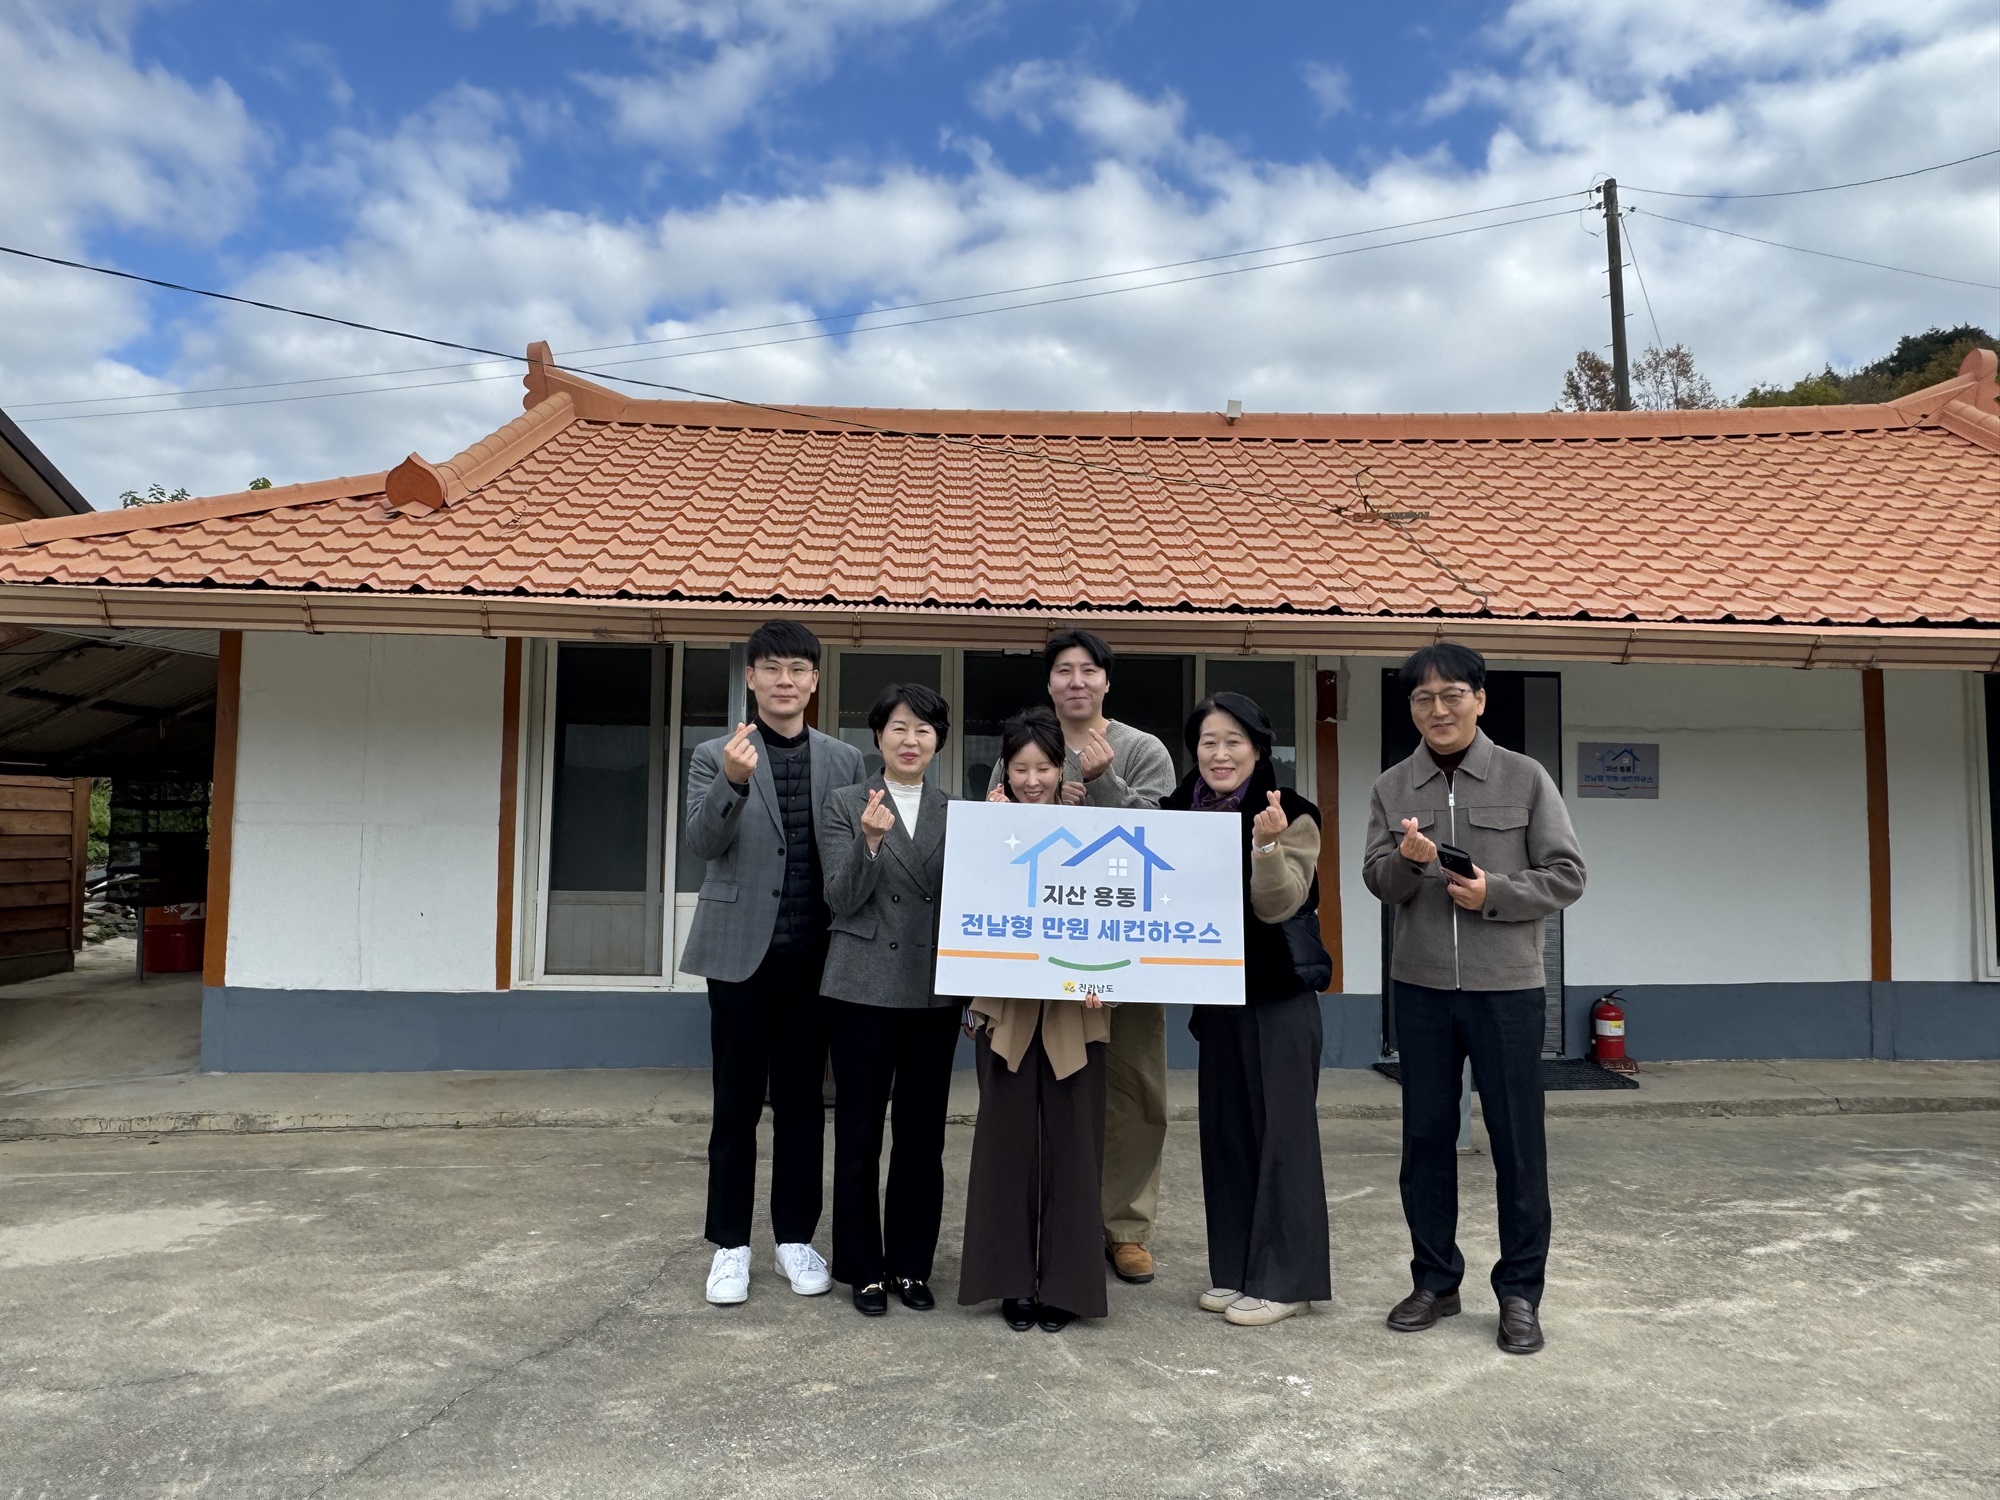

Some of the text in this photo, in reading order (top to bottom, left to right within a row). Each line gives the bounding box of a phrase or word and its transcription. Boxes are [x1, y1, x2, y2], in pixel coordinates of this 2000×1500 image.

[1042, 884, 1137, 908] 지산 용동
[163, 904, 179, 914] SK
[961, 913, 1222, 944] 전남형 만원 세컨하우스
